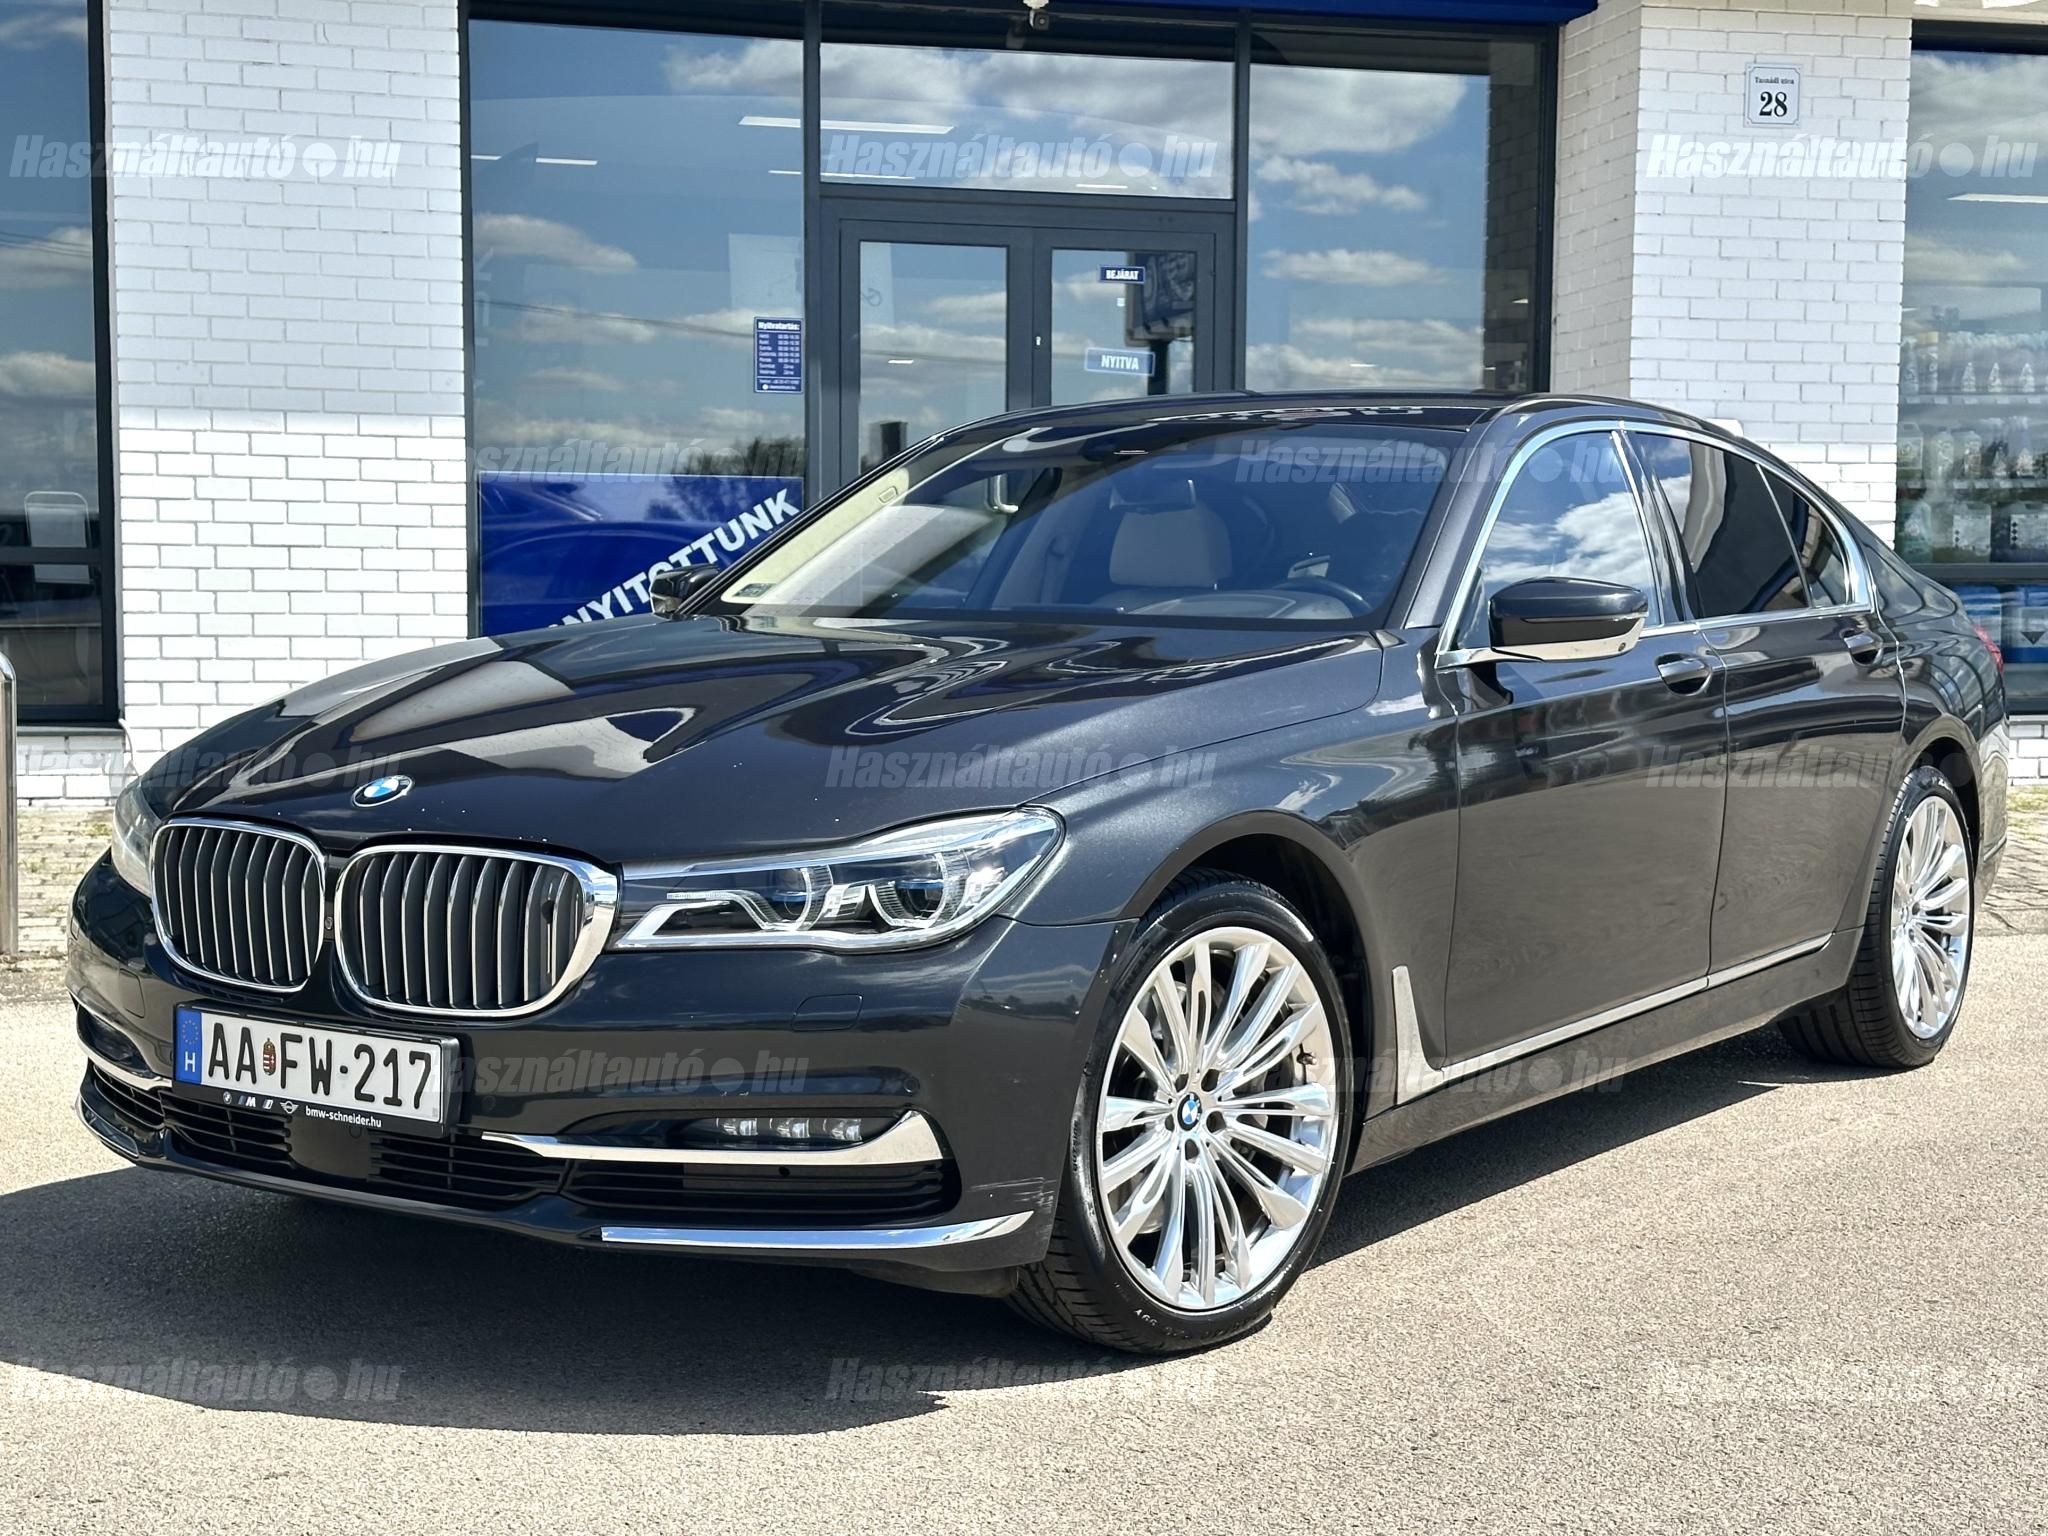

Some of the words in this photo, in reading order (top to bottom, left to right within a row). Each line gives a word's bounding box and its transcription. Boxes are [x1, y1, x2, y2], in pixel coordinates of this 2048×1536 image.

[1759, 91, 1788, 117] 28
[1106, 269, 1139, 281] BEJÁRAT
[1101, 354, 1140, 370] NYITVA
[185, 1051, 196, 1073] H
[208, 1022, 257, 1085] AA
[306, 1105, 382, 1128] bmw-schneider.hu
